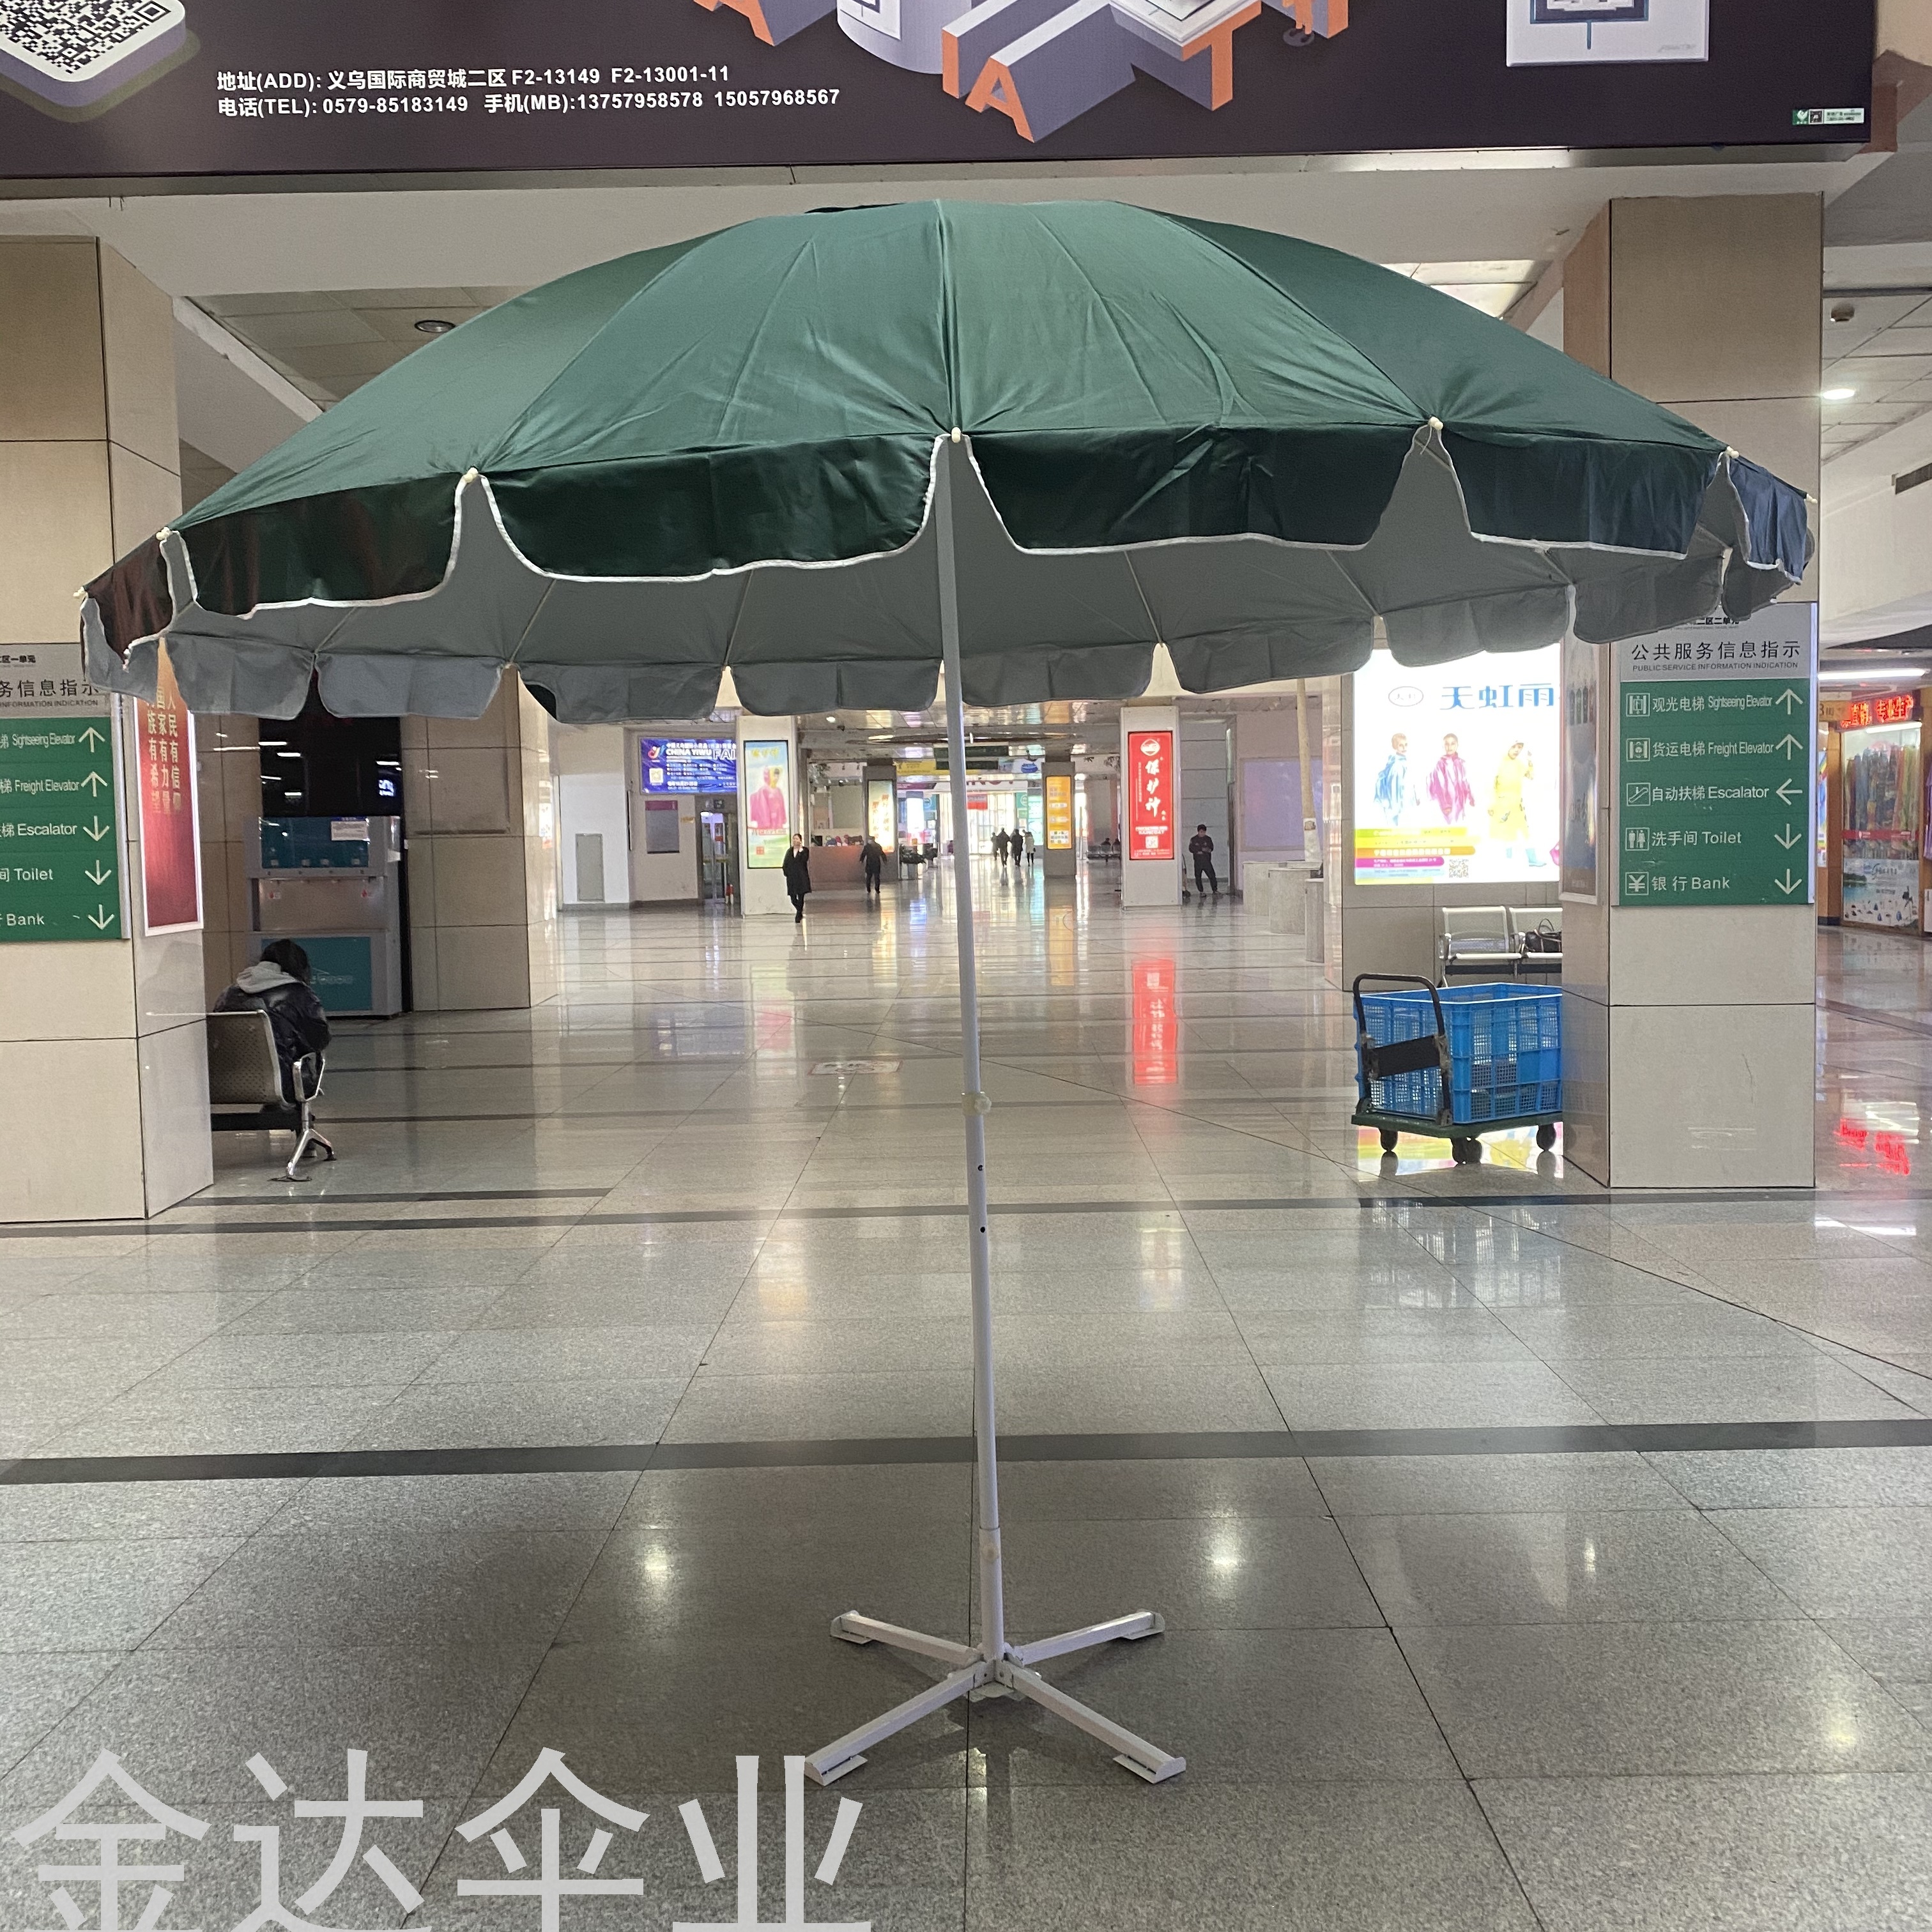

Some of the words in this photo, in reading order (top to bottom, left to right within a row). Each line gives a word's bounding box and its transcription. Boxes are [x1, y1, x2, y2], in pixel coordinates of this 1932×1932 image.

[217, 71, 321, 92] 地址(ADD):
[327, 68, 507, 90] 义乌国际商贸城二区
[512, 68, 600, 85] F2-13149
[611, 65, 728, 83] F2-13001-11
[218, 96, 317, 118] 电话(TEL):
[323, 96, 468, 114] 0579-85183149
[714, 89, 840, 107] 15057968567
[1631, 640, 1800, 661] 公共服务信息指示
[1662, 663, 1696, 671] SERVICE
[1698, 662, 1752, 670] INFORMATION
[1652, 696, 1705, 712] 观光电梯
[1708, 695, 1745, 711] Sightseeing
[1746, 694, 1773, 707] Elevator
[49, 733, 75, 745] Elevator
[146, 702, 161, 813] 族有希望
[167, 692, 181, 811] 人民有信
[1652, 741, 1705, 758] 货运电梯
[1708, 742, 1738, 757] Freight
[1739, 741, 1774, 754] Elevator
[15, 779, 44, 795] Freight
[45, 779, 80, 792] Elevator
[1652, 785, 1705, 802] 自动扶梯
[1708, 786, 1770, 799] Escalator
[17, 822, 78, 836] Escalator
[1652, 831, 1698, 847] 洗手间
[1701, 831, 1742, 844] Toilet
[13, 868, 53, 880] Toilet
[1652, 876, 1688, 891] 银行
[1692, 877, 1730, 889] Bank
[6, 913, 45, 926] Bank
